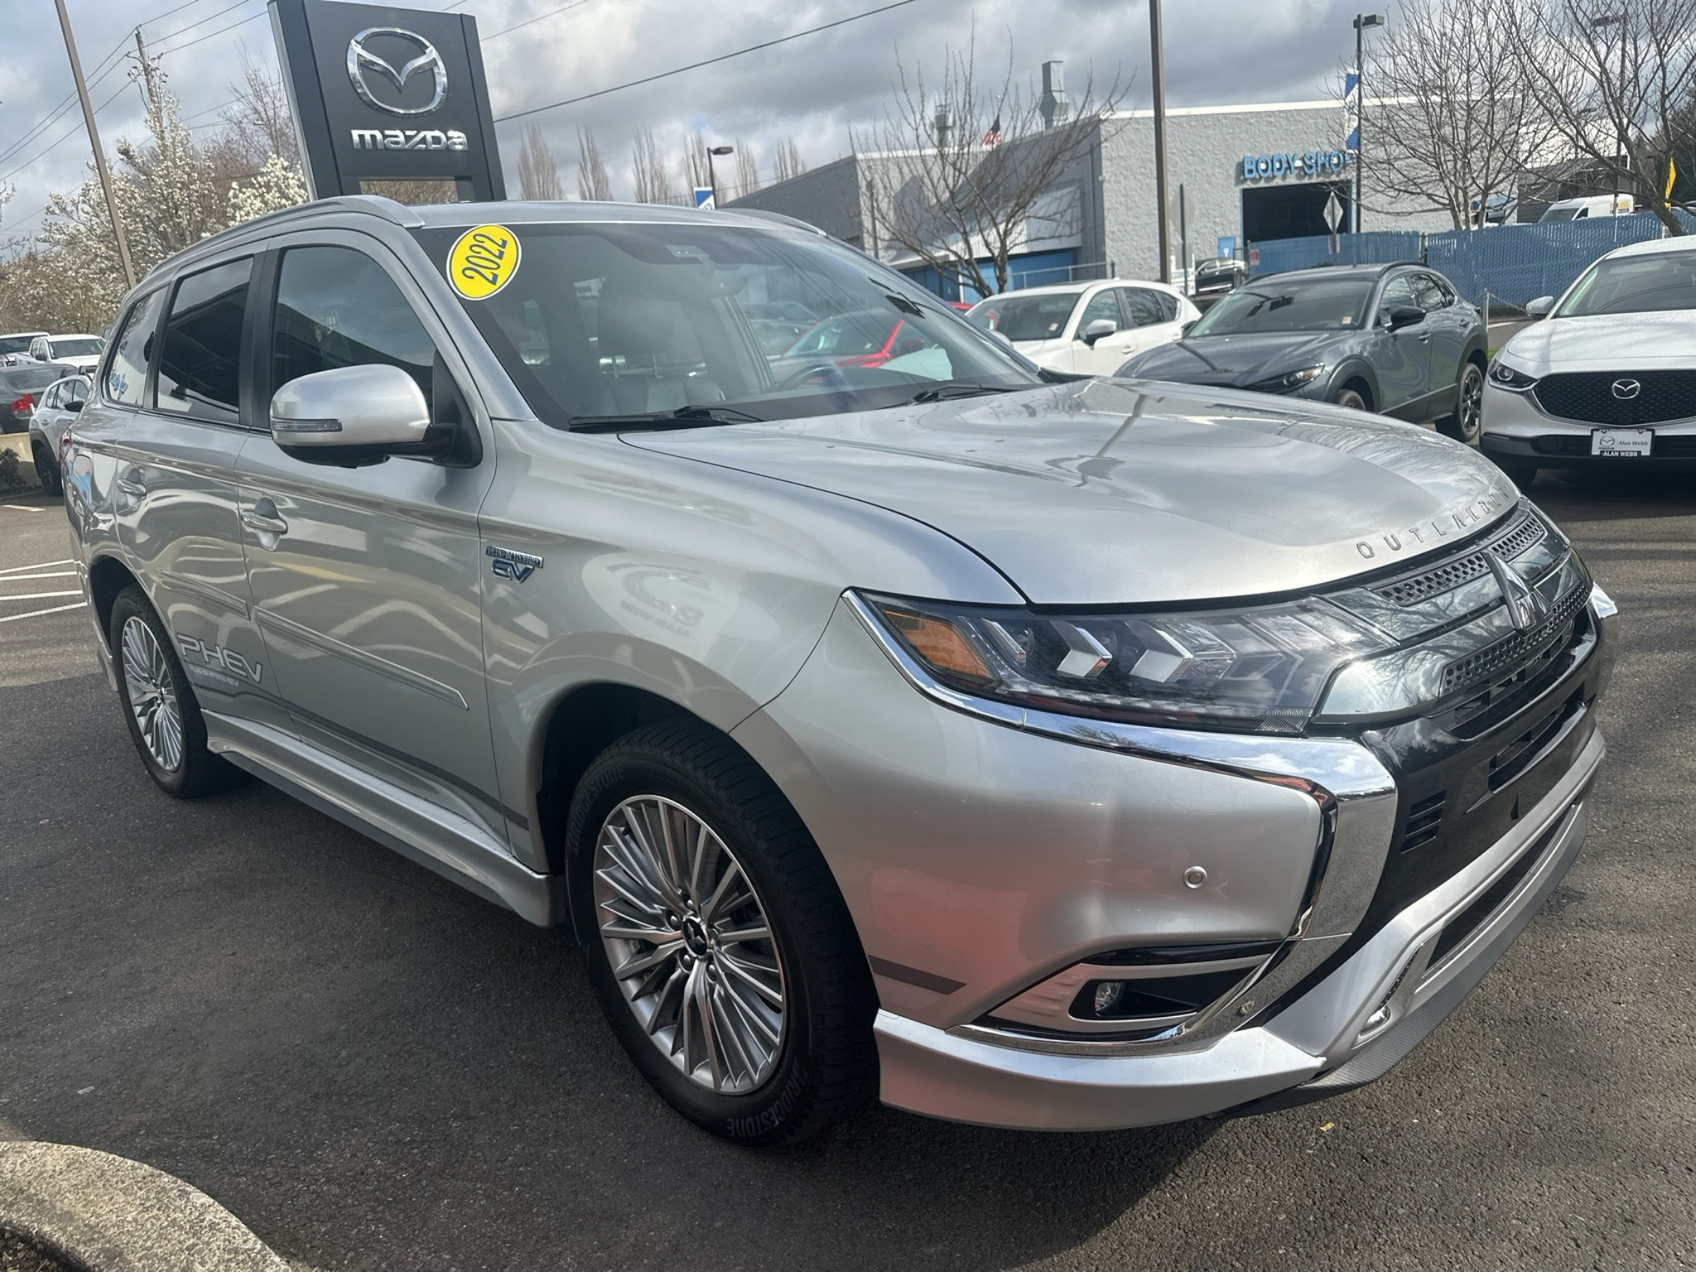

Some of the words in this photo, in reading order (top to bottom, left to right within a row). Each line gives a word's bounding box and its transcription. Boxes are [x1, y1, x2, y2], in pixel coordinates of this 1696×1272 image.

[351, 129, 469, 151] mazda
[1243, 152, 1297, 179] BODY
[461, 233, 508, 286] 2022
[1356, 488, 1510, 559] OUTLANDE
[492, 558, 535, 583] EV
[177, 633, 262, 684] PHEV
